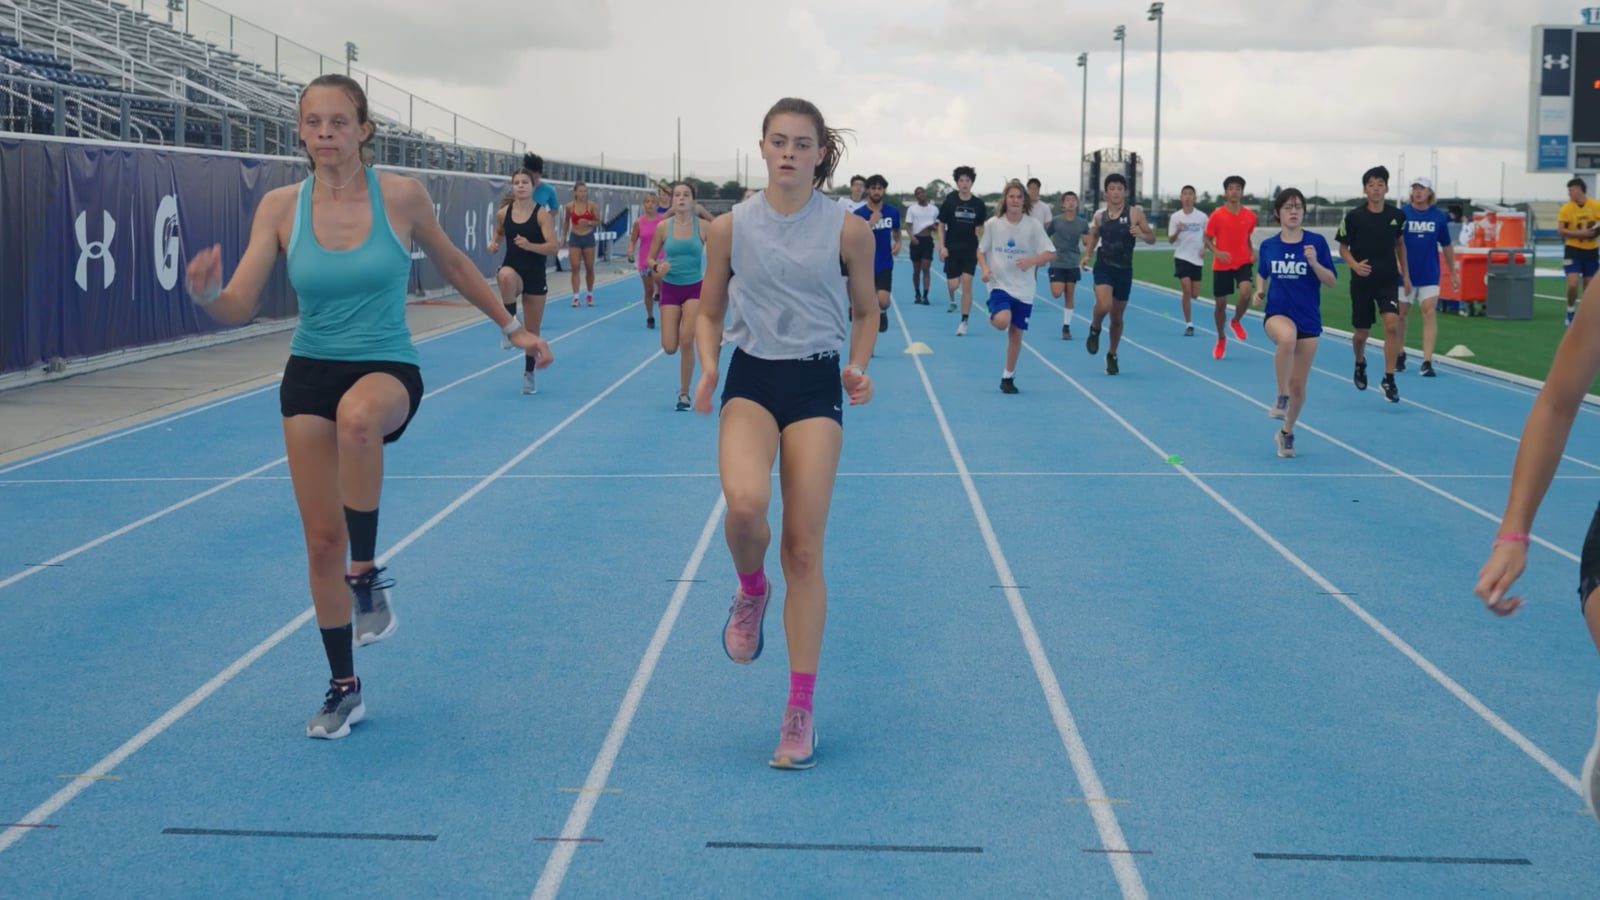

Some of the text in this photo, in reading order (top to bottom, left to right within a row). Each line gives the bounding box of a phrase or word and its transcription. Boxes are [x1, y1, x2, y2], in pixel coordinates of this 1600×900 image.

[872, 217, 893, 230] MG
[1408, 221, 1436, 232] IMG
[1271, 260, 1308, 275] IMG
